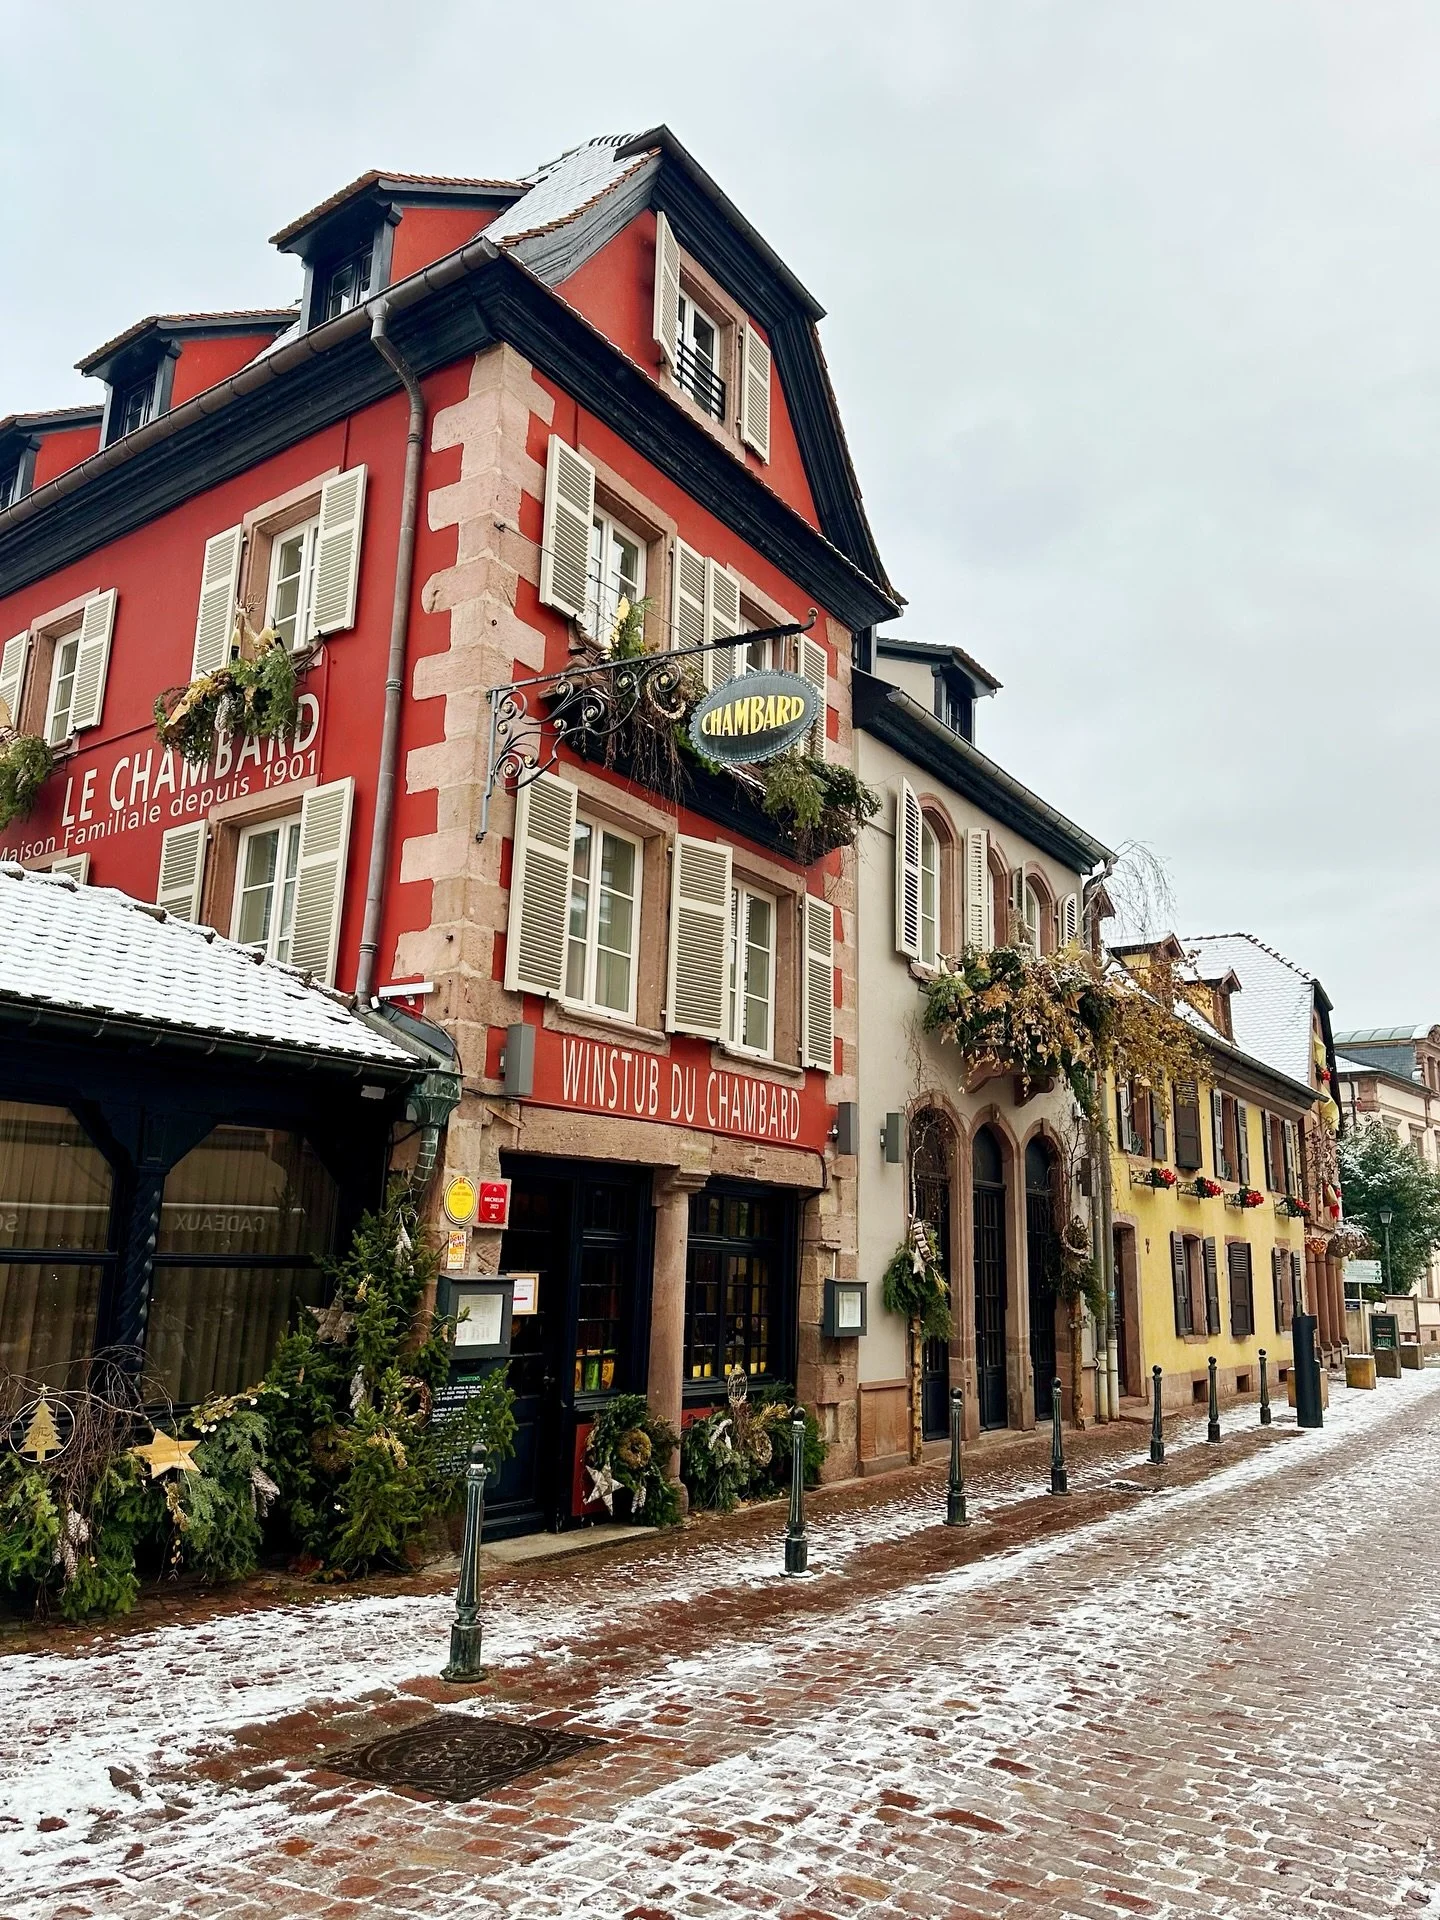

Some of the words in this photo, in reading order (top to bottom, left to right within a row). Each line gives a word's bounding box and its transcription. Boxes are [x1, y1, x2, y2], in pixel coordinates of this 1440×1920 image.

[701, 695, 805, 737] CHAMBARD
[61, 769, 97, 827] LE
[63, 801, 161, 847] Familiale
[169, 773, 250, 814] depuis
[262, 750, 317, 788] 1901
[562, 1038, 659, 1116] WINSTUB
[670, 1063, 697, 1124] DU
[706, 1071, 801, 1141] CHAMBARD
